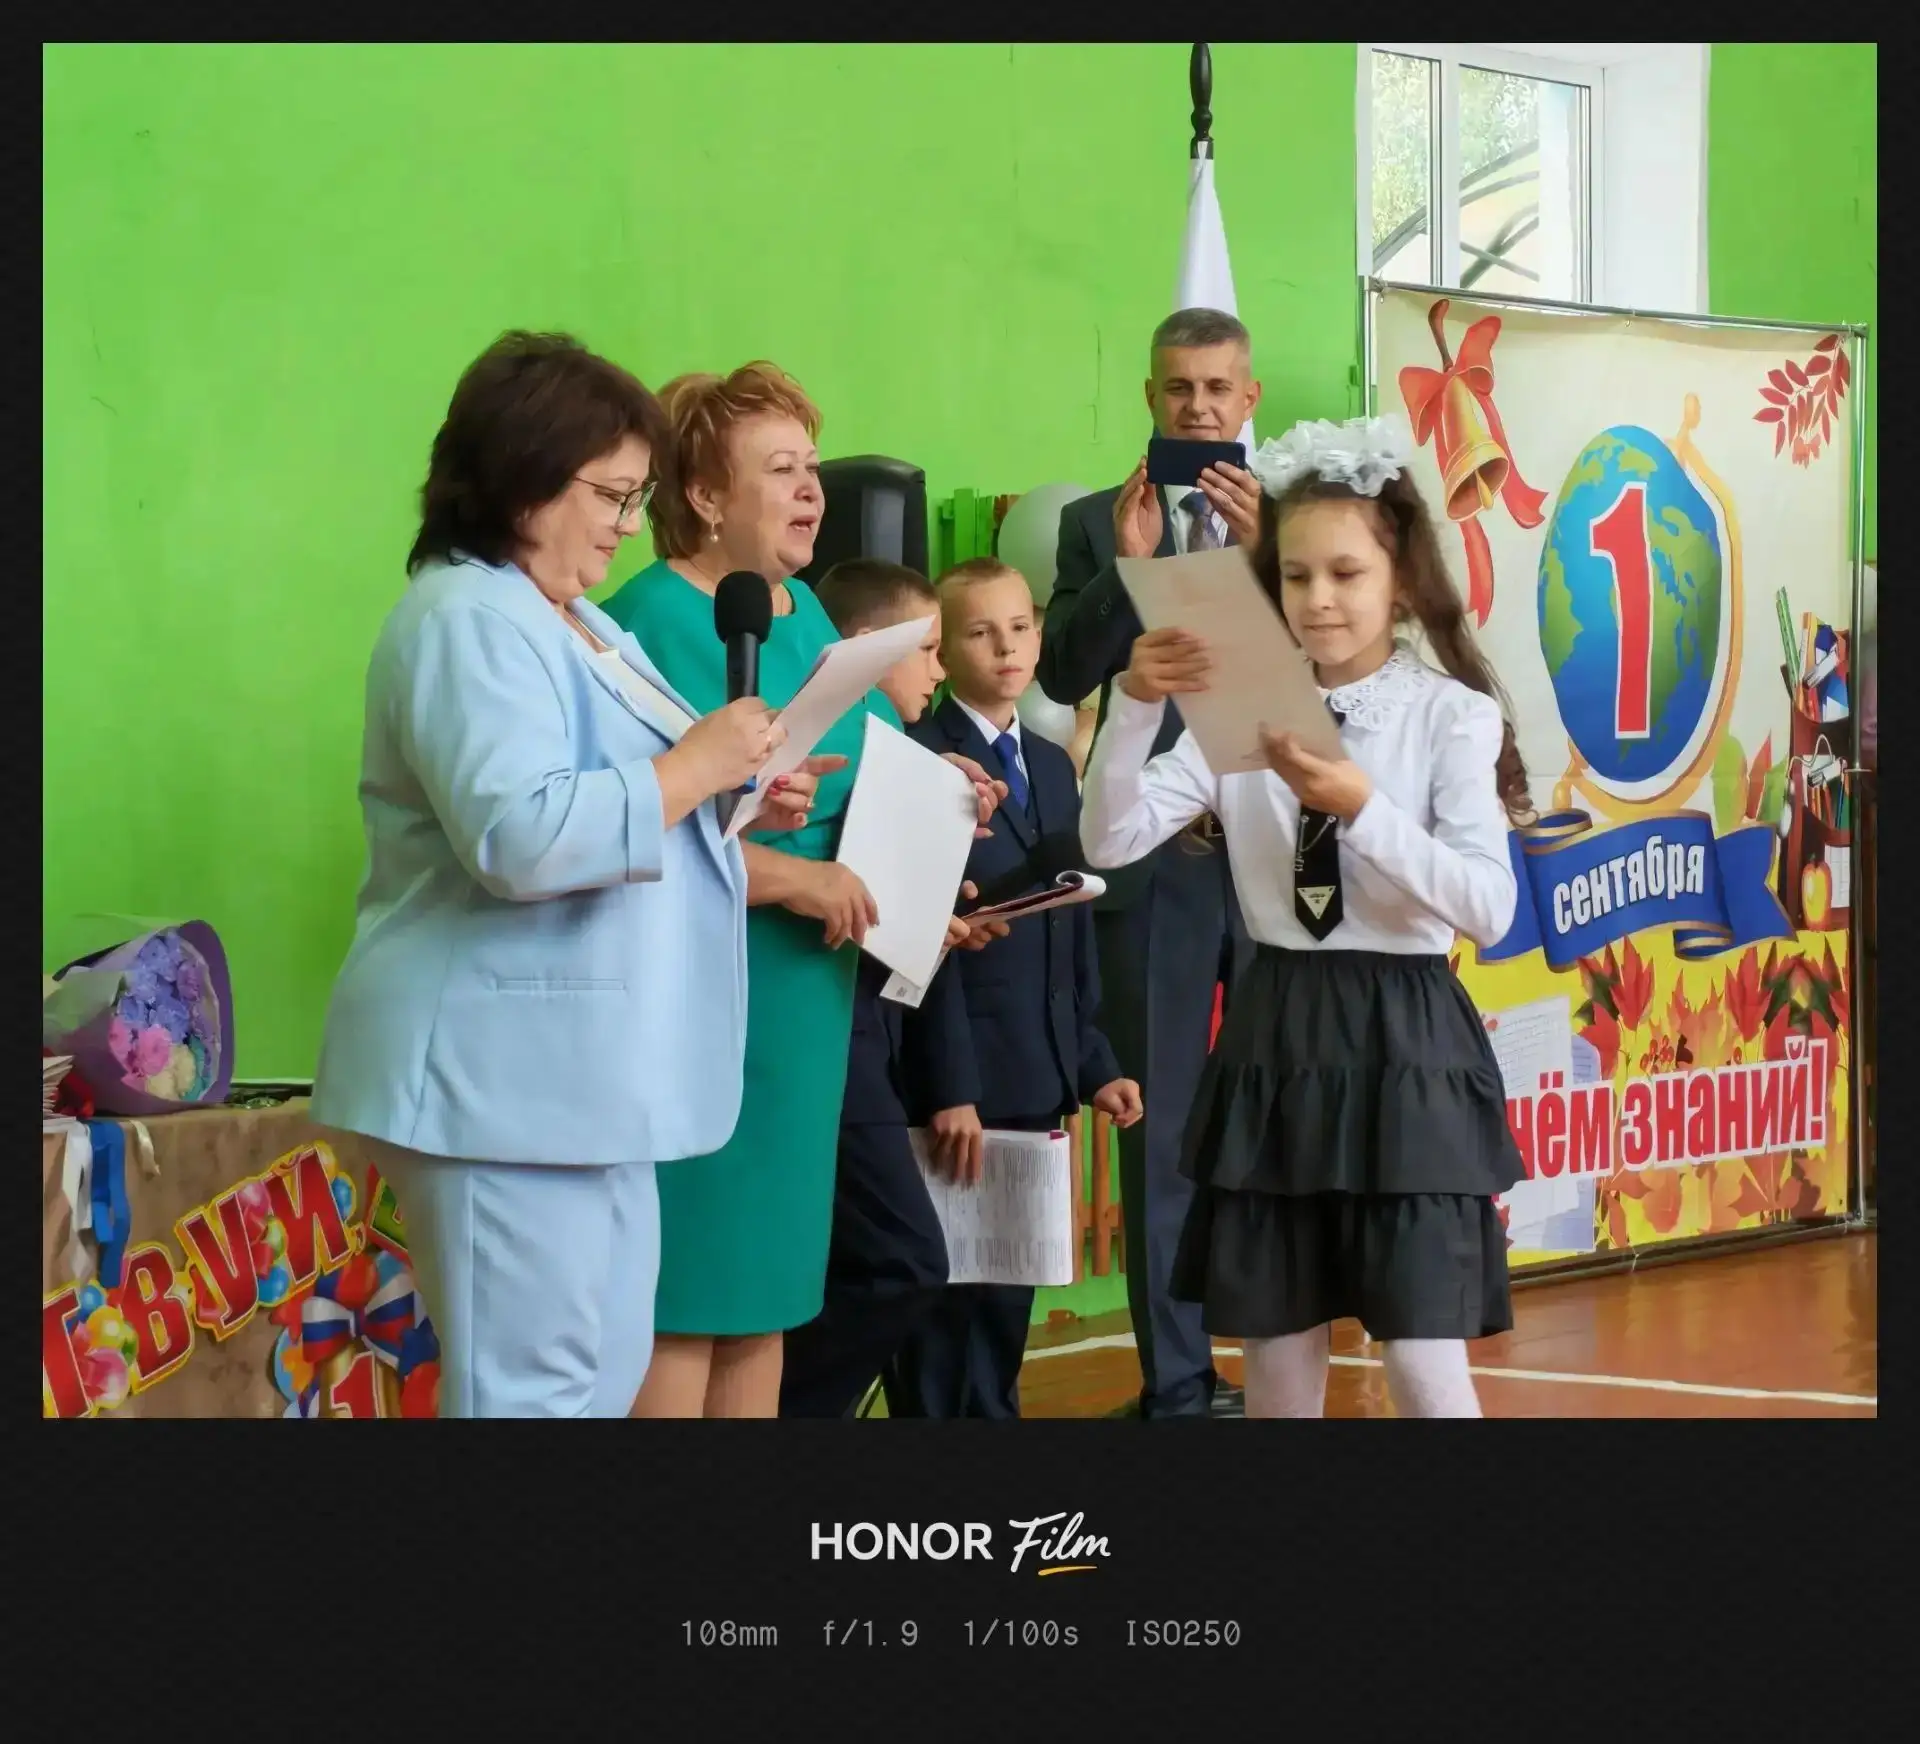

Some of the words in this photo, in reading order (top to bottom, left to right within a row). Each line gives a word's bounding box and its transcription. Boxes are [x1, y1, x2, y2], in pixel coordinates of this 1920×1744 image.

[1590, 478, 1654, 739] 1
[1553, 834, 1705, 935] сентября
[1505, 1070, 1611, 1181] нём
[1622, 1038, 1826, 1168] знаний!
